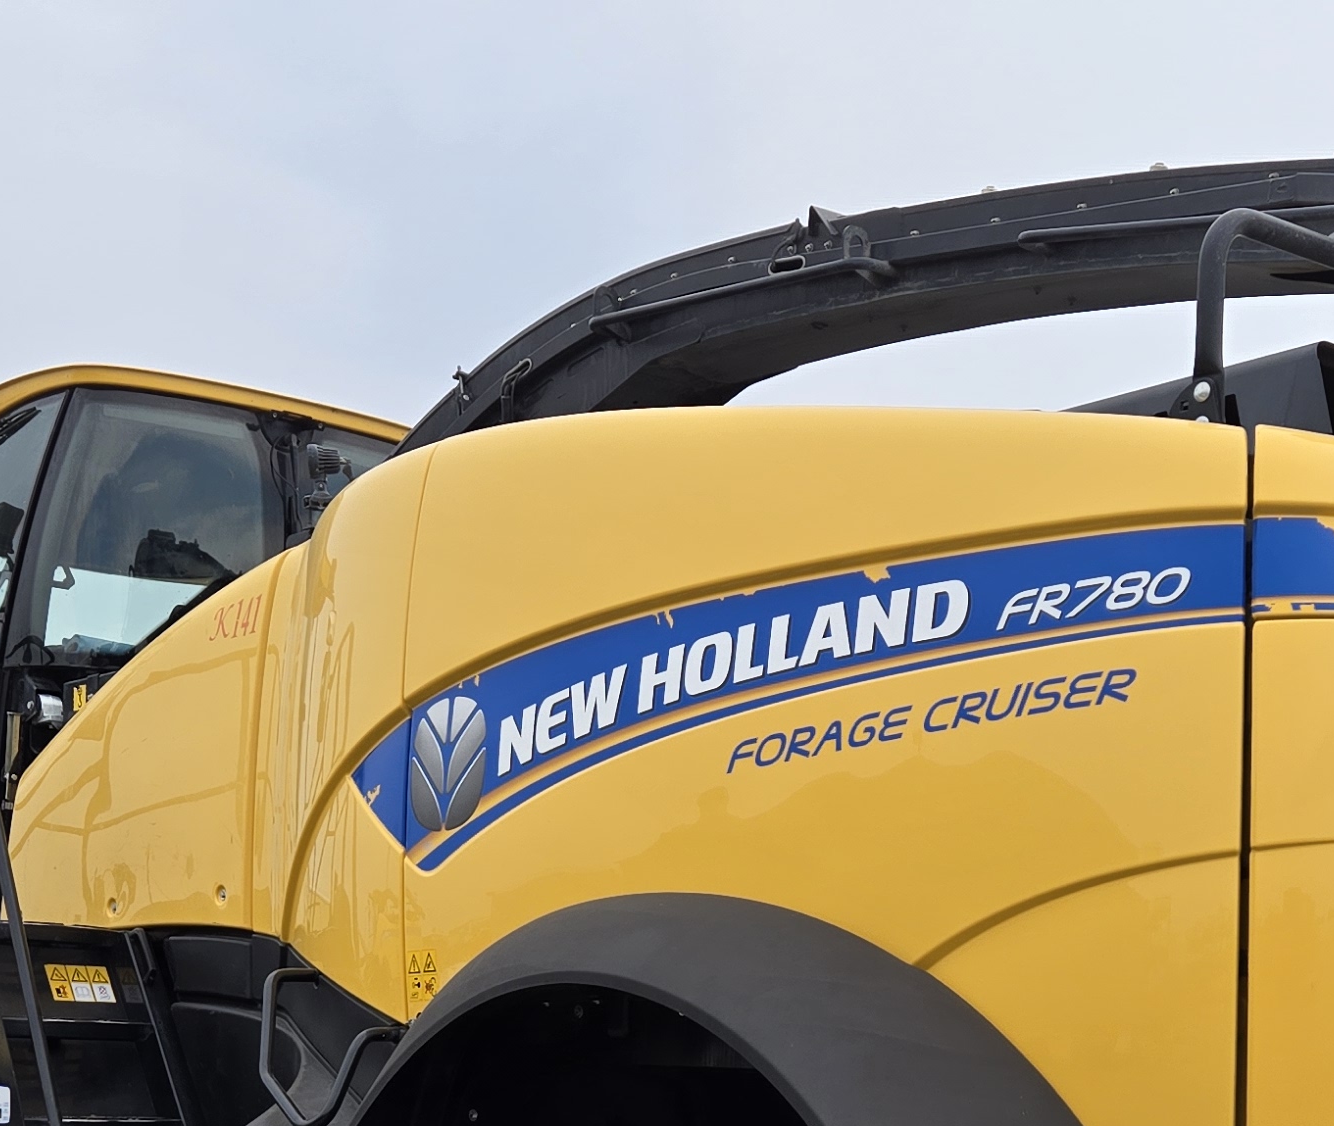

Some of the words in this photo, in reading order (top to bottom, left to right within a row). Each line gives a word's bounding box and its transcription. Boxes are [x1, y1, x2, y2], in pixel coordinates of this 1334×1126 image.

[209, 594, 263, 642] K141
[996, 567, 1191, 631] FR780
[497, 663, 628, 777] NEW
[637, 579, 969, 714] HOLLAND
[726, 705, 913, 774] FORAGE
[924, 669, 1137, 733] CRUISER
